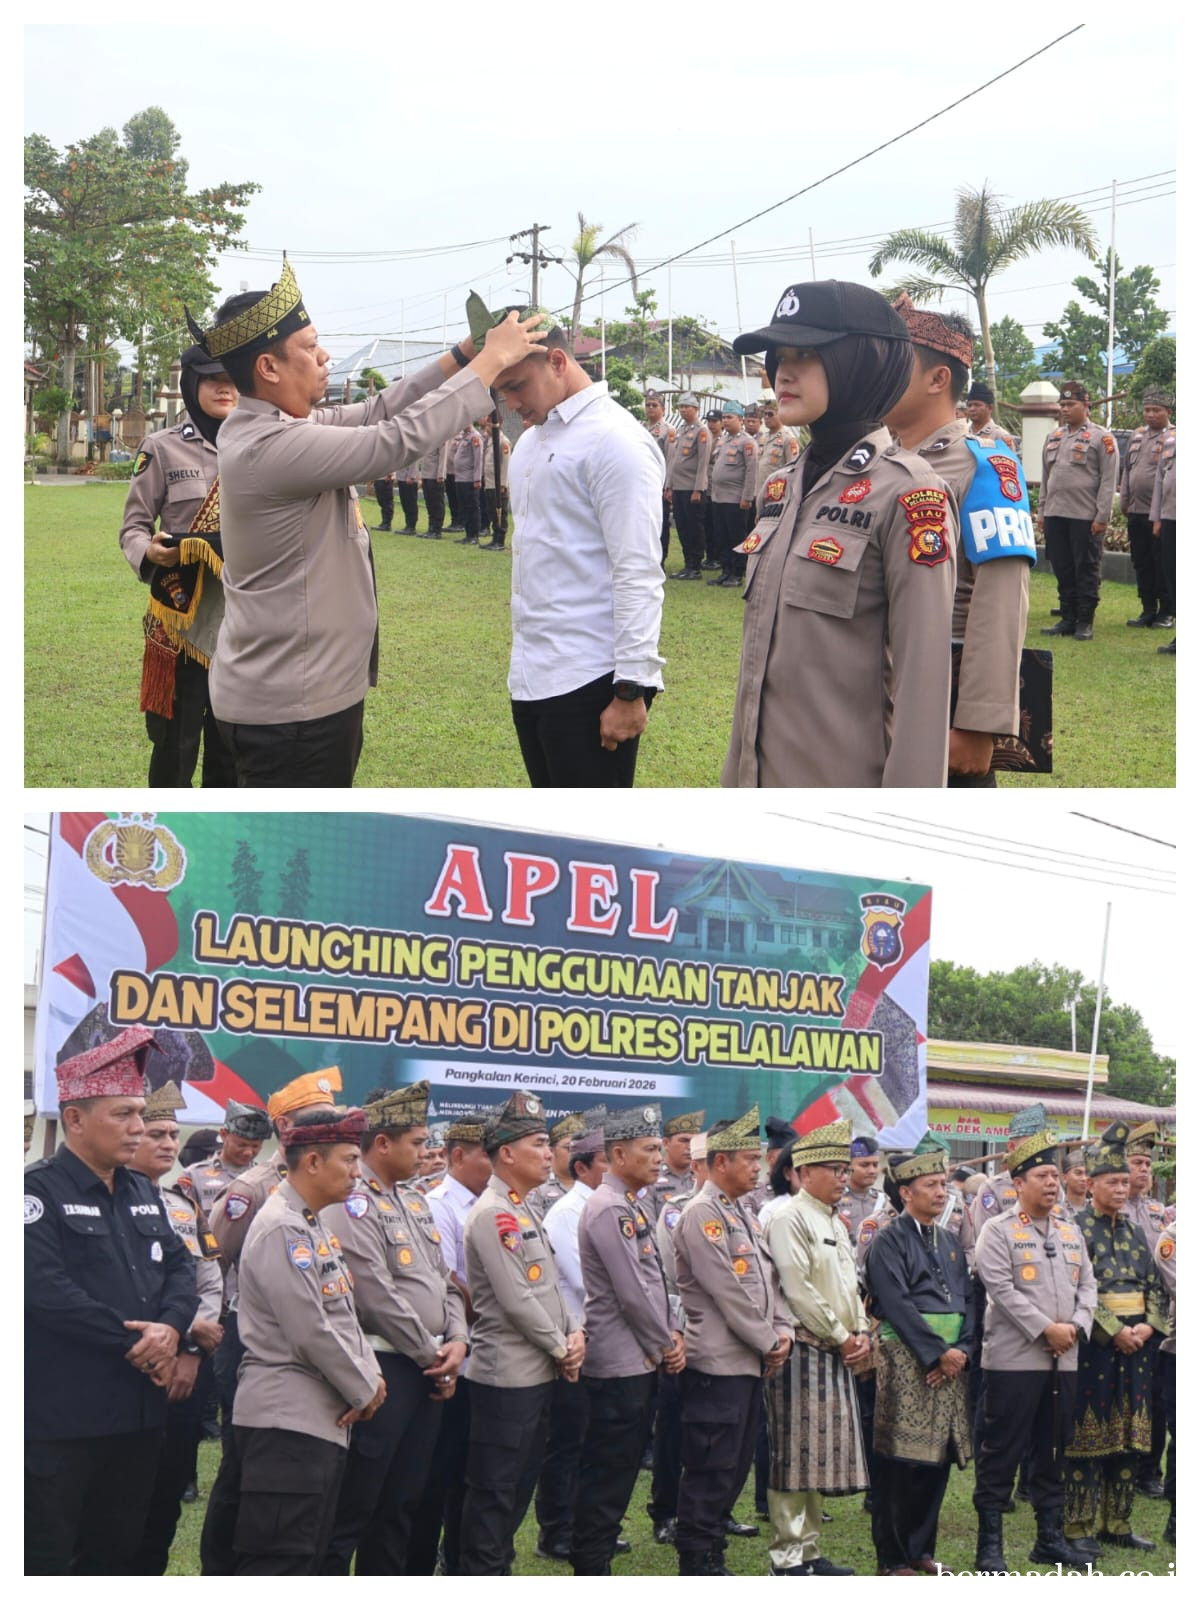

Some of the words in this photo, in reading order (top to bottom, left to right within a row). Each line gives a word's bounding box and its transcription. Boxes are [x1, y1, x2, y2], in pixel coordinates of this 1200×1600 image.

[167, 469, 200, 481] SHELLY
[903, 490, 945, 504] POLRES
[815, 505, 873, 530] POLRI
[911, 510, 942, 519] RIAU
[426, 844, 678, 943] APEL
[196, 915, 451, 983] LAUNCHING
[457, 941, 710, 1006] PENGGUNAAN
[713, 967, 845, 1017] TANJAK
[112, 971, 217, 1029] DAN
[222, 980, 486, 1049] SELEMPANG
[491, 1003, 532, 1051] DI
[536, 1007, 682, 1062] POLRES
[684, 1019, 883, 1074] PELALAWAN
[445, 1067, 511, 1083] Pangkalan
[513, 1072, 560, 1086] Kerinci,
[561, 1075, 577, 1086] 20
[578, 1075, 627, 1089] Februari
[628, 1078, 657, 1091] 2026
